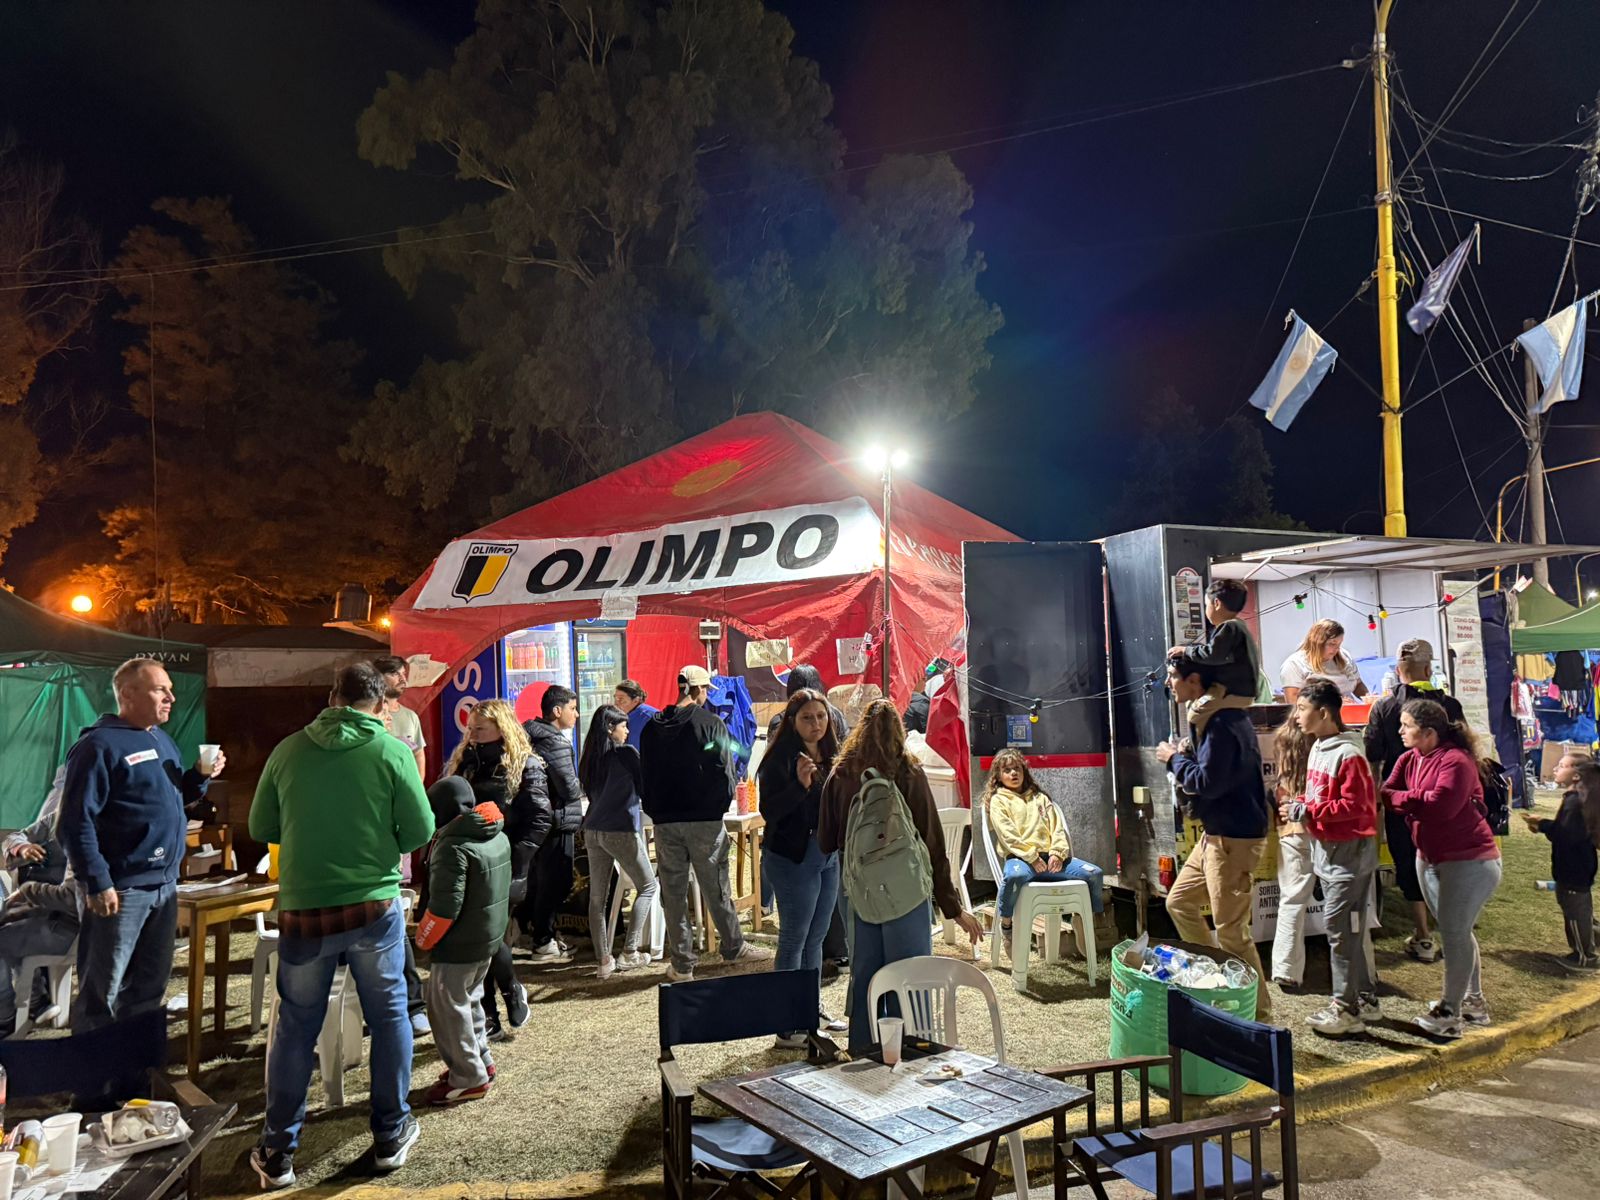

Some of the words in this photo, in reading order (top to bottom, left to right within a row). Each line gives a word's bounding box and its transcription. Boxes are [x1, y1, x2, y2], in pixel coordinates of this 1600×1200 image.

[472, 545, 514, 555] OLIMPO
[526, 513, 840, 595] OLIMPO
[1305, 905, 1325, 914] AULT
